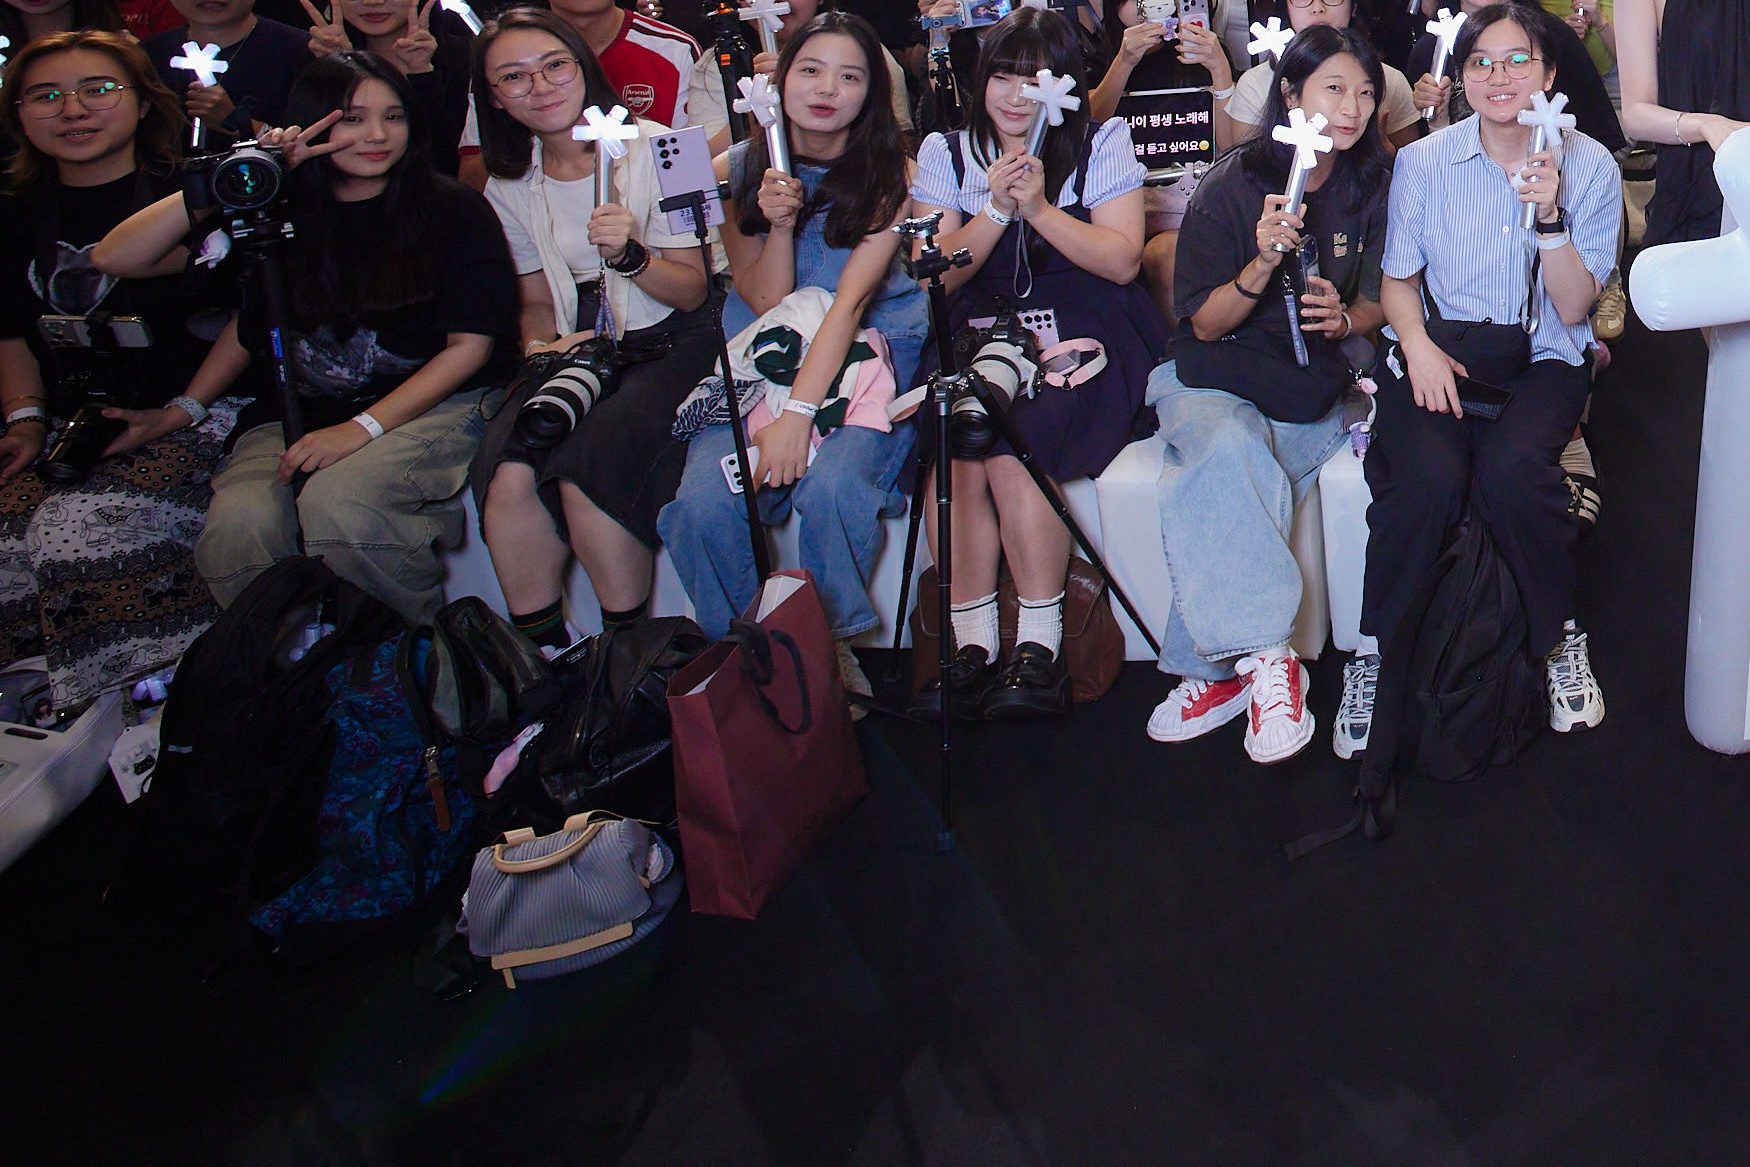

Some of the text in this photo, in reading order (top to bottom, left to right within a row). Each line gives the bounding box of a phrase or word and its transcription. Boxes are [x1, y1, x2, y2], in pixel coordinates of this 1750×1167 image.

[1149, 113, 1173, 128] 평생
[1174, 110, 1209, 125] 노래해
[1146, 142, 1167, 155] 듣고
[1168, 140, 1200, 153] 싶어요
